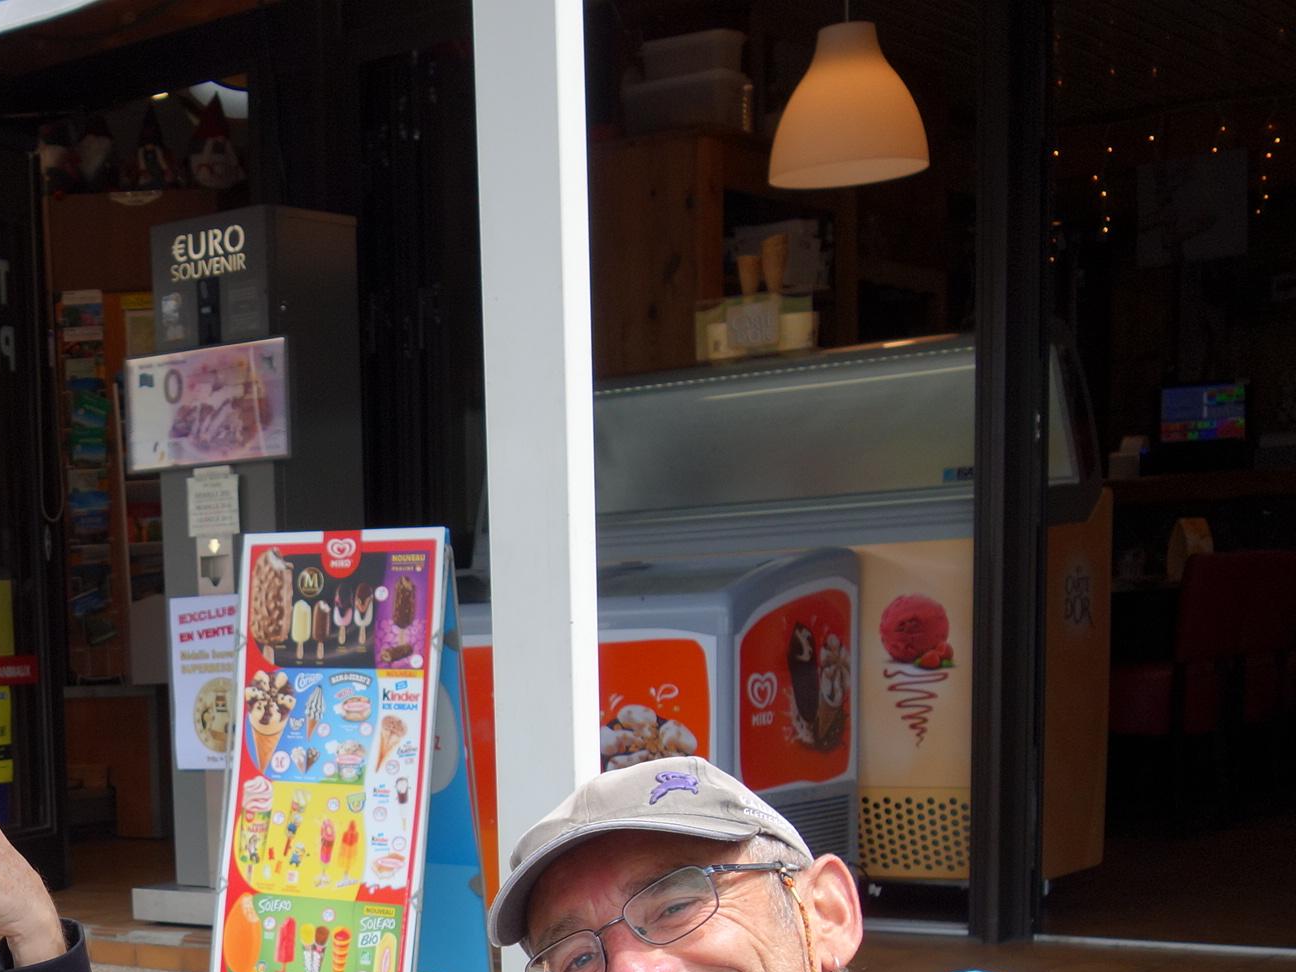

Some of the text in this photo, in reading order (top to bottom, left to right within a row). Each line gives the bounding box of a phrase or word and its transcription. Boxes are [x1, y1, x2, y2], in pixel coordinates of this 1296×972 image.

[171, 224, 245, 262] €URO
[170, 252, 247, 282] SOUVENIR
[164, 369, 183, 404] 0
[391, 554, 426, 563] NOUVEAU
[197, 625, 234, 641] VENTE
[382, 687, 420, 702] Kinder
[382, 703, 418, 712] ICE CREAM
[751, 711, 773, 727] MIKO
[258, 896, 292, 914] SOLERO
[365, 907, 394, 916] NOUVEAU
[359, 917, 396, 931] SOLERO
